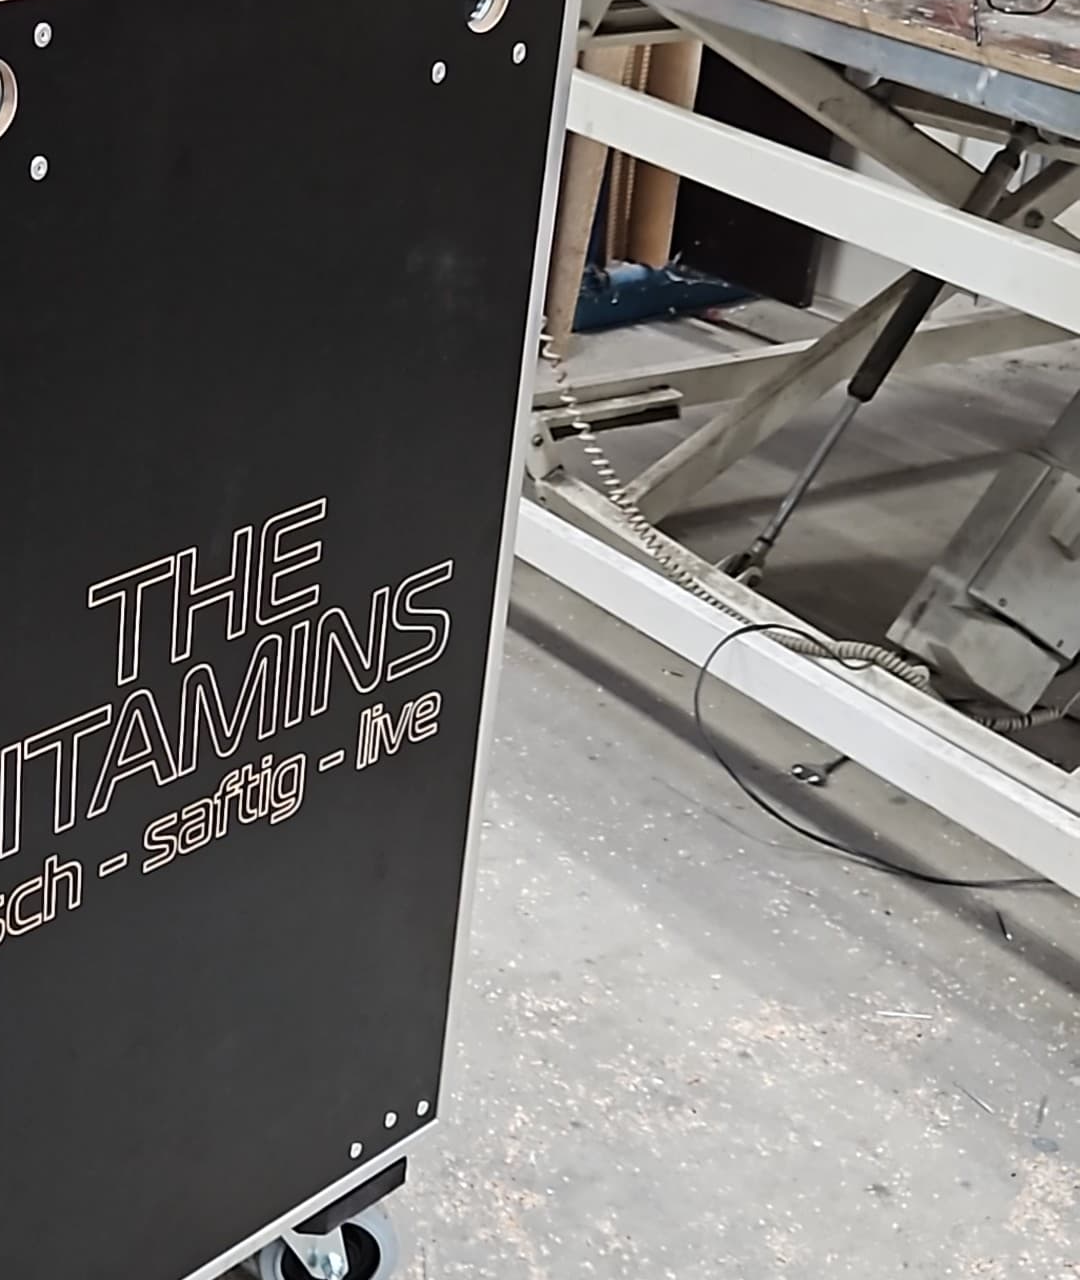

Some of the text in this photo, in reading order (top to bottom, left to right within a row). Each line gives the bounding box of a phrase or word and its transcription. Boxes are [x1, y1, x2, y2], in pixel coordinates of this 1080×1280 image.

[88, 497, 327, 686] THE
[142, 753, 306, 874] saftig
[356, 691, 442, 770] live
